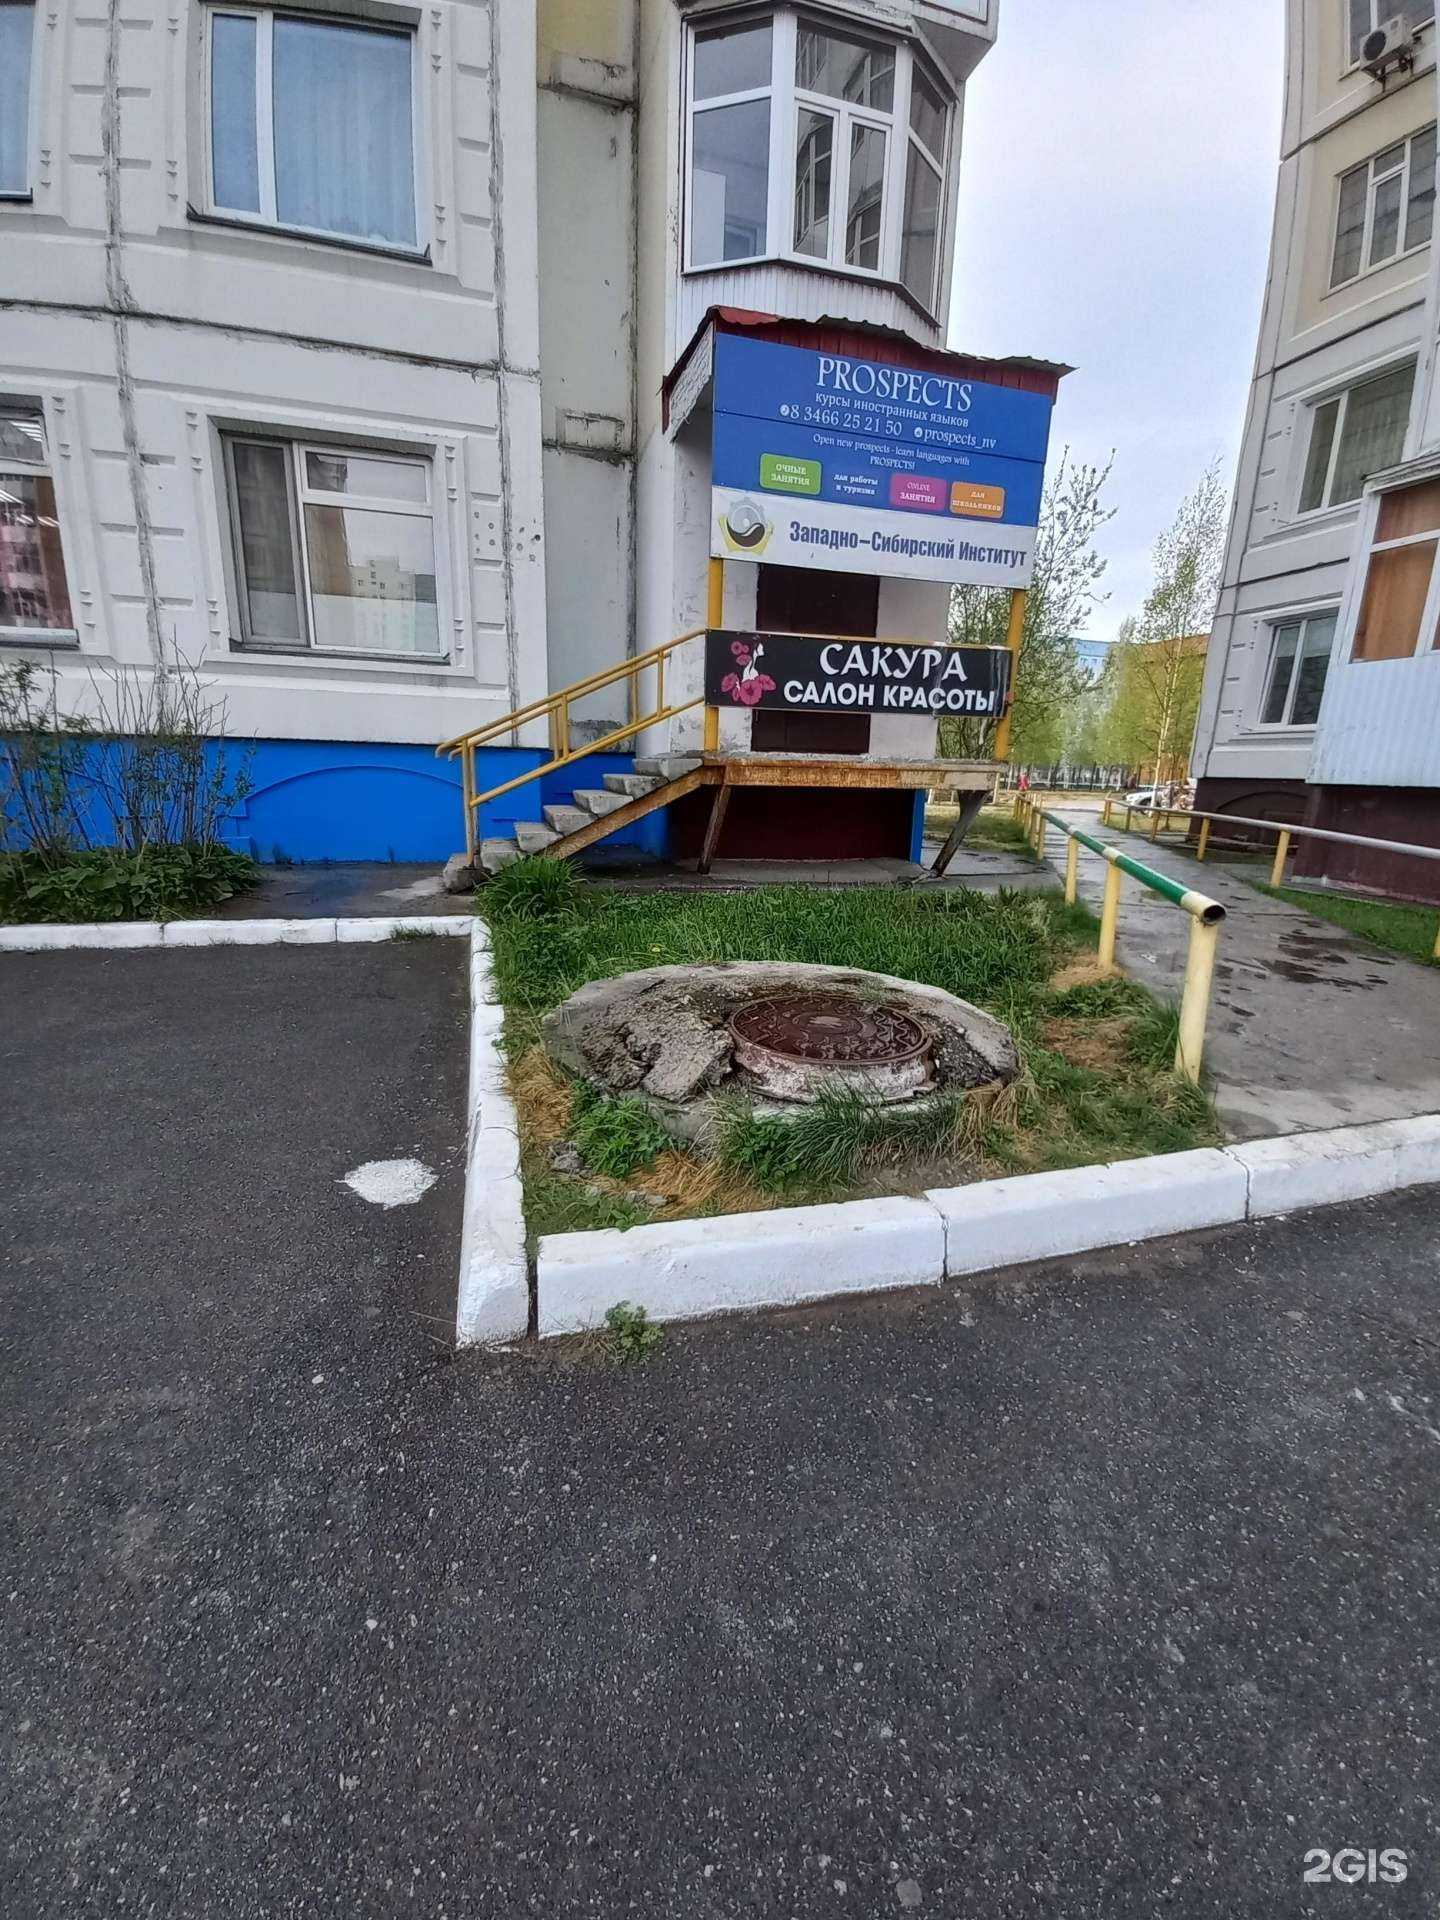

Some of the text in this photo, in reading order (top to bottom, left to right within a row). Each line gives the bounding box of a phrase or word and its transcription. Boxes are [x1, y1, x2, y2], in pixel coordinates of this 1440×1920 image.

[816, 357, 972, 412] PROSPECTS
[815, 392, 969, 428] курсы иностранных языков
[790, 404, 997, 449] 8 3466 25 21 50 prospects_nv
[813, 433, 835, 446] Open
[836, 439, 854, 448] new
[855, 441, 890, 454] prospects
[895, 446, 915, 457] learn
[916, 449, 952, 465] languages
[953, 456, 970, 466] with
[770, 473, 810, 486] ЗАНЯТИЯ
[775, 463, 807, 475] ОЧНЫЕ
[850, 475, 879, 486] работы
[900, 491, 937, 504] ЗАНЯТИЯ
[958, 541, 1027, 568] Институт
[819, 643, 968, 682] САКУРА
[783, 680, 996, 712] САЛОН КРАСОТЫ
